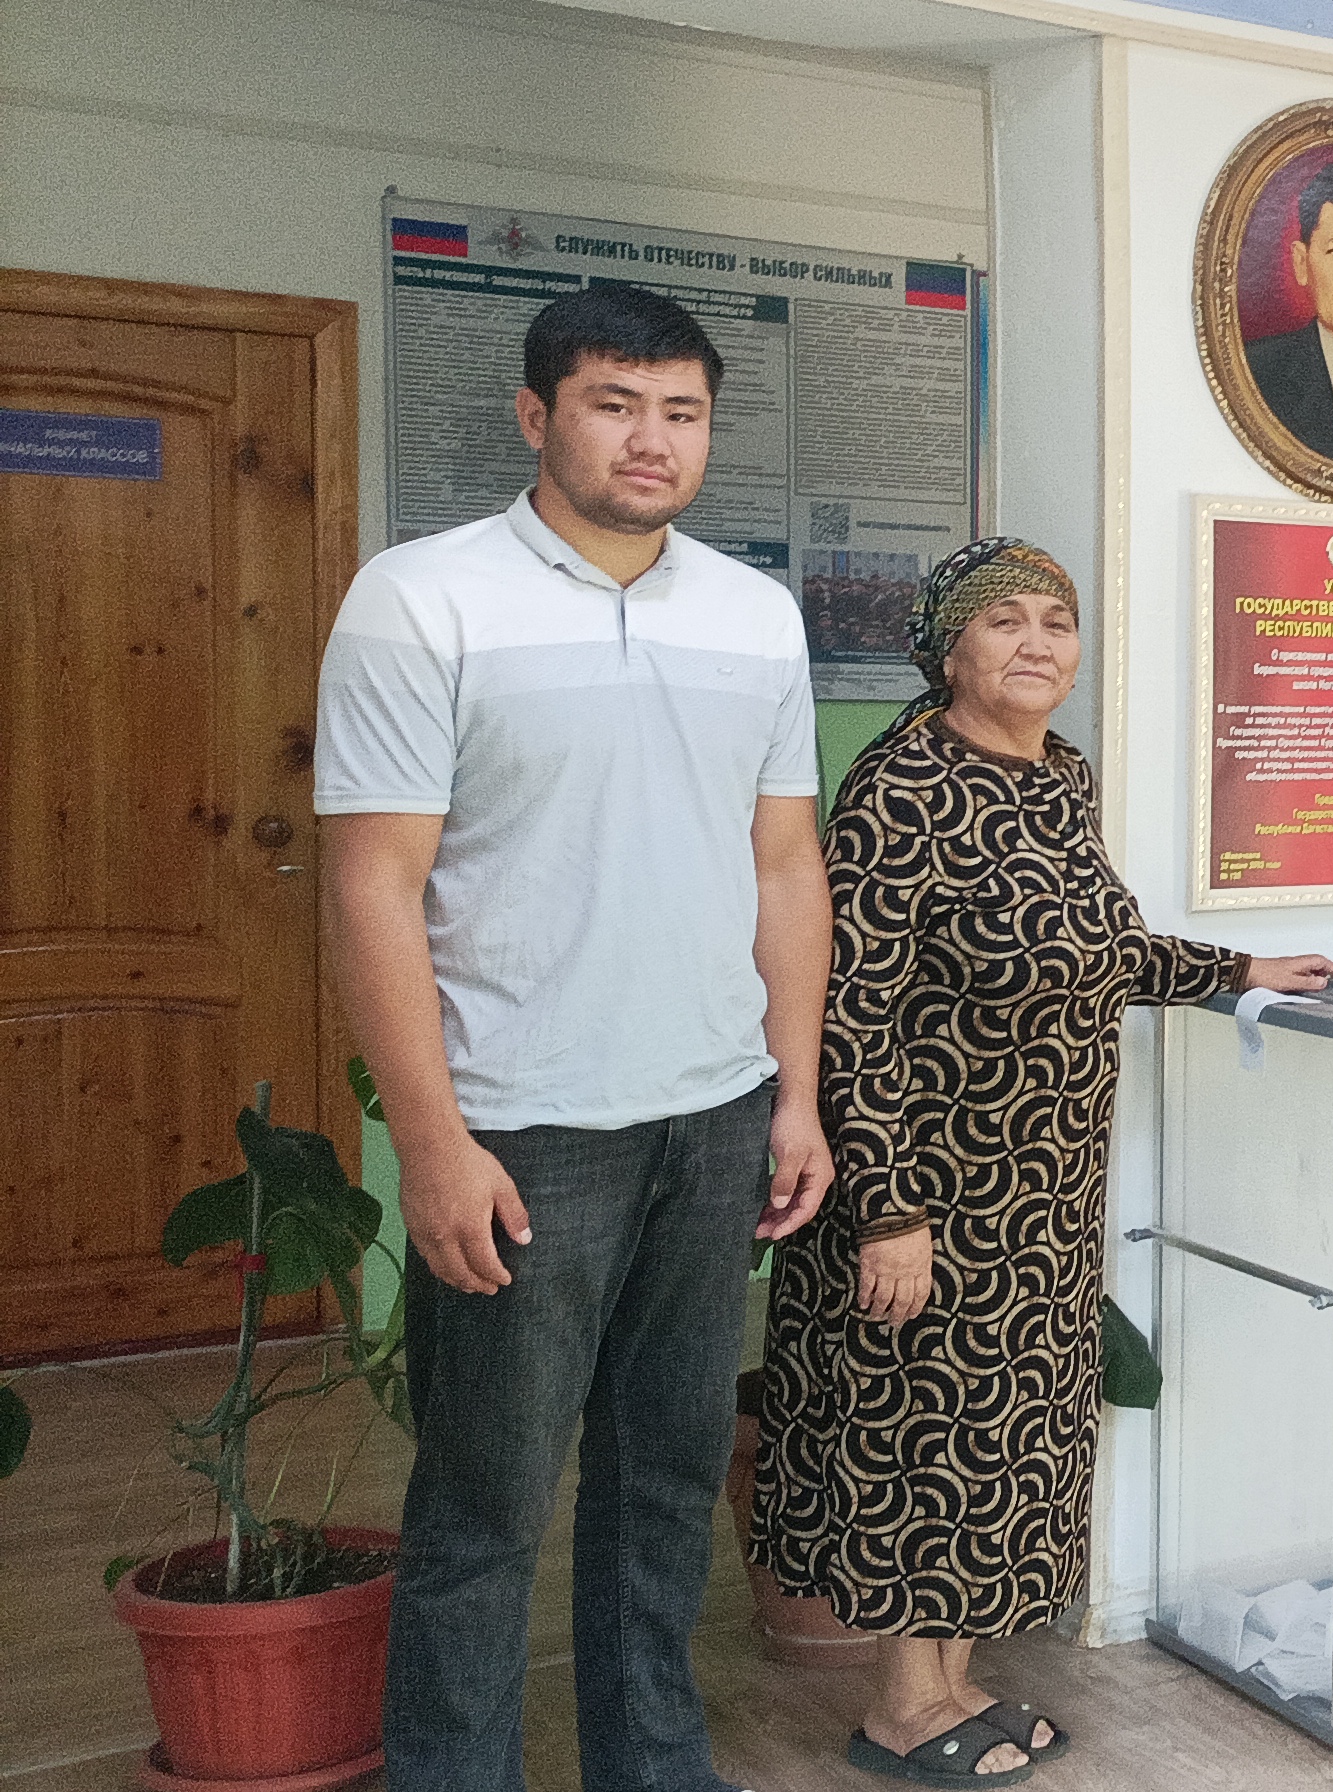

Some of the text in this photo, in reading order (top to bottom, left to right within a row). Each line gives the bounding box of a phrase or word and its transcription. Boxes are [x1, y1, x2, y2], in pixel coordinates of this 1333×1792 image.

[555, 234, 639, 261] СЛУЖИТЬ
[643, 244, 737, 272] ОТЕЧЕСТВУ
[750, 256, 810, 280] ВЫБОР
[812, 266, 894, 290] СИЛЬНЫХ
